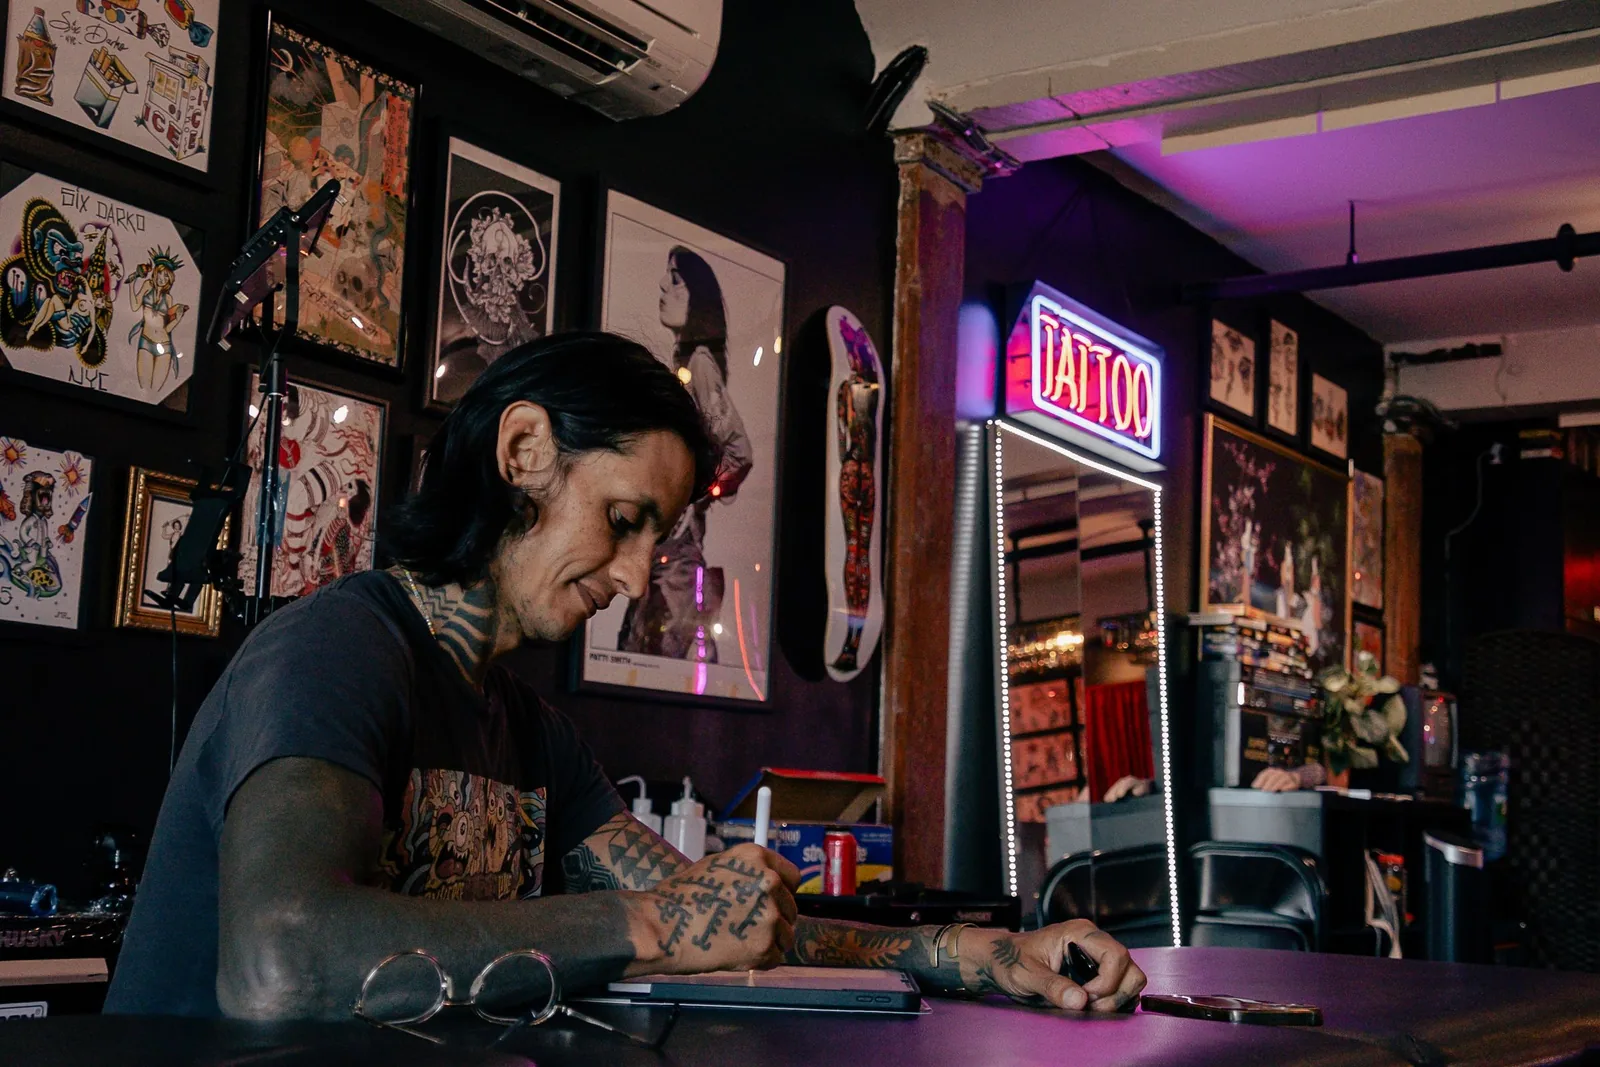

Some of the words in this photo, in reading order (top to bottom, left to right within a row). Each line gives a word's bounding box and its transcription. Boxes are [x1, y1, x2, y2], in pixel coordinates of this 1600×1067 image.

[84, 24, 129, 51] Darko
[143, 103, 183, 149] ICE
[96, 200, 145, 235] DARKO
[68, 364, 109, 391] NYC
[1039, 314, 1154, 438] TATTOO
